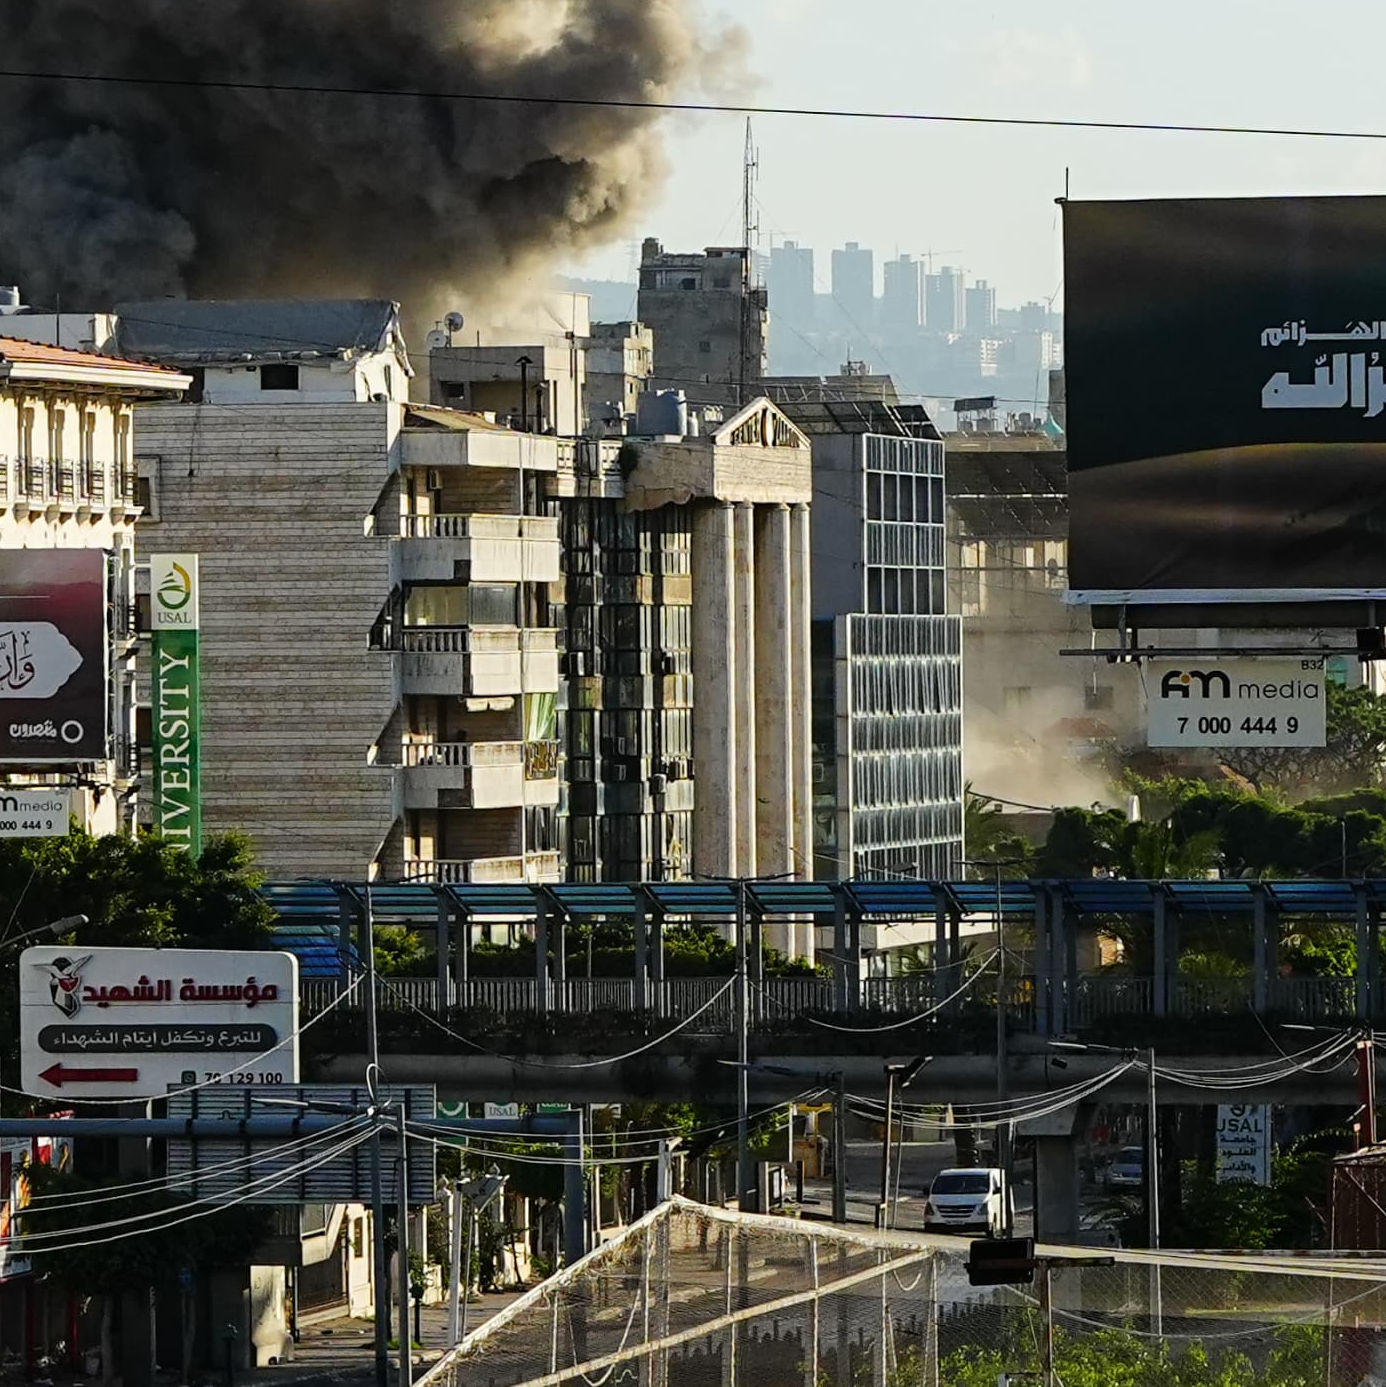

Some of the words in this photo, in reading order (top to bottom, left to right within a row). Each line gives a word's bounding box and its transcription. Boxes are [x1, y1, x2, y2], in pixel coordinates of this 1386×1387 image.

[157, 611, 192, 624] USAL
[1301, 660, 1324, 670] B32
[1238, 681, 1319, 699] media
[1177, 717, 1189, 734] 7
[1198, 717, 1232, 735] 000
[1240, 717, 1278, 734] 444
[1287, 717, 1299, 734] 9
[19, 800, 63, 812] media
[0, 820, 18, 830] 000
[21, 820, 42, 830] 444
[82, 975, 172, 1008] الشهيد
[179, 976, 279, 1009] مؤسسة
[53, 1029, 119, 1049] الشهداء
[160, 1029, 215, 1047] وتكفل
[217, 1030, 261, 1047] للتبرع
[228, 1072, 255, 1084] 129
[258, 1072, 283, 1084] 100
